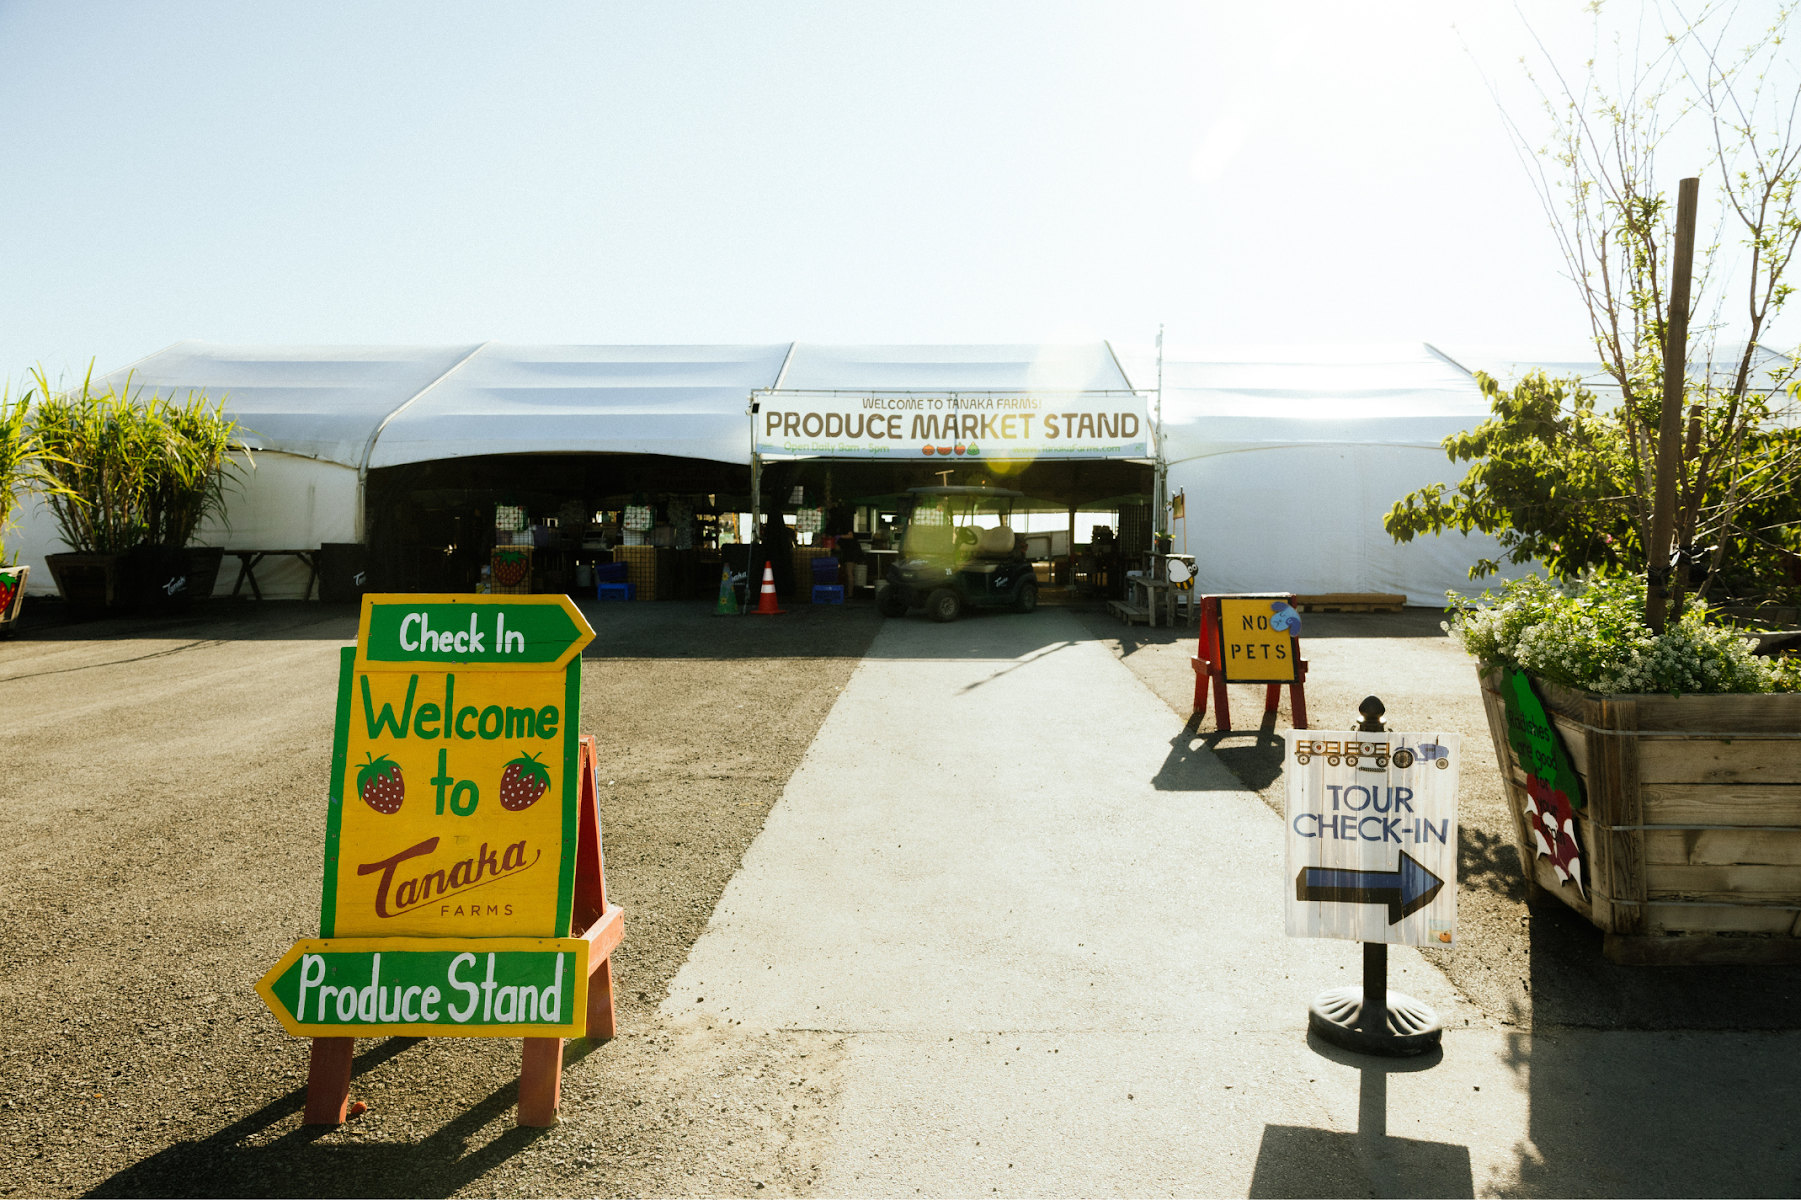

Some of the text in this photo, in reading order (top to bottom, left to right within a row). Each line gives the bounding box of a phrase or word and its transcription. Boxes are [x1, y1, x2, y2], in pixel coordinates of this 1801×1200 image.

[863, 398, 1042, 410] WELCOME TO TANAKA FARMS!
[766, 411, 1139, 440] PRODUCE MARKET STAND
[784, 441, 810, 453] Open
[811, 442, 836, 453] Daily
[838, 442, 860, 452] 9am
[868, 443, 890, 454] 5pm
[1012, 443, 1121, 453] www.TanakaFarms.com
[400, 612, 525, 653] Check In
[1242, 615, 1268, 631] NO
[1231, 644, 1286, 659] PETS
[360, 673, 560, 740] Welcome
[1508, 709, 1551, 742] Radishes
[1517, 742, 1558, 772] are good
[430, 748, 479, 816] to
[1534, 767, 1549, 791] for
[1326, 784, 1414, 813] TOUR
[1293, 813, 1449, 845] CHECK-IN
[357, 836, 541, 919] Tanaka
[440, 904, 513, 917] FARMS
[296, 951, 564, 1023] Produce Stand
